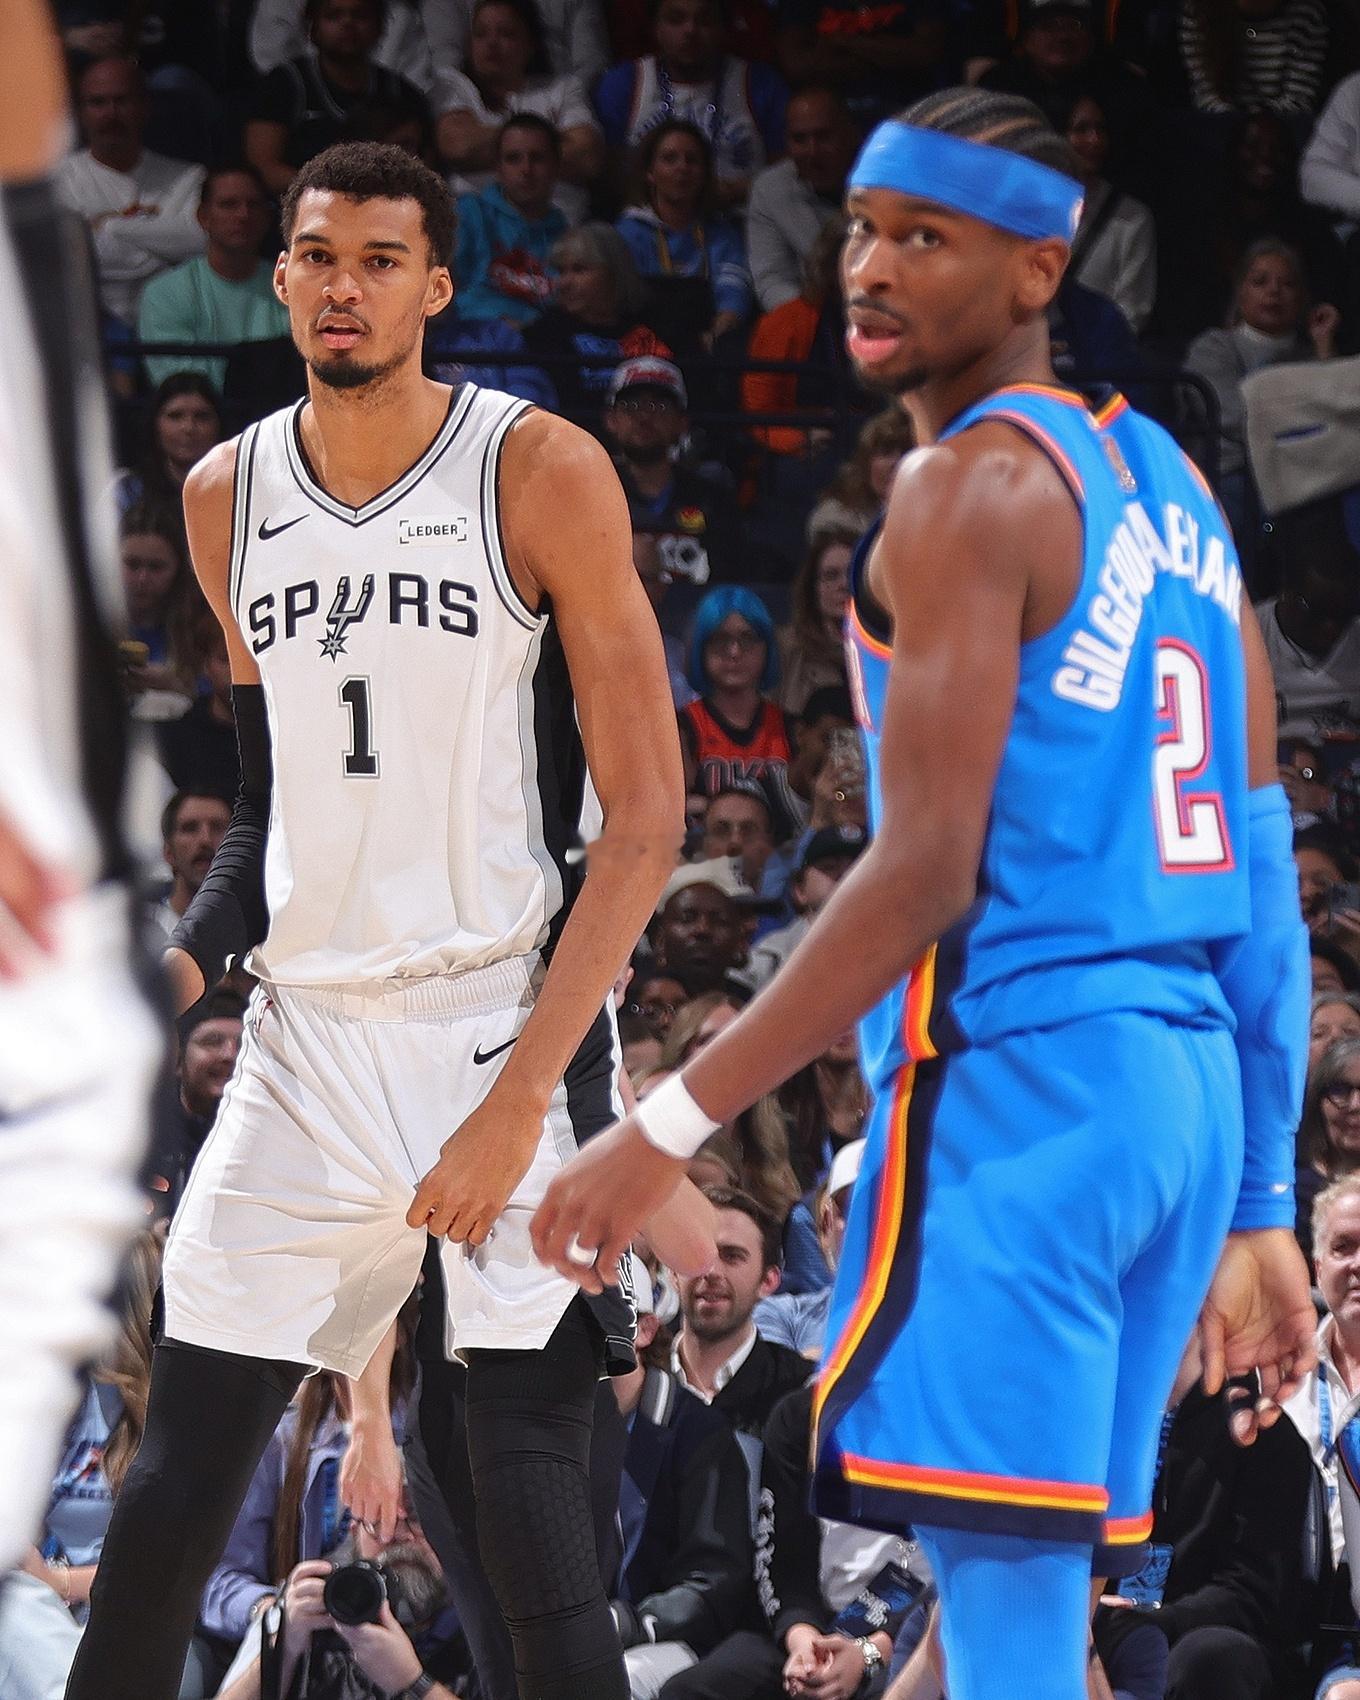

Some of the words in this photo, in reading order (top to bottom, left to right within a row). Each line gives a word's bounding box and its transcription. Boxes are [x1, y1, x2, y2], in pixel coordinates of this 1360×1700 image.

[407, 523, 458, 537] LEDGER
[249, 572, 479, 663] SPURS
[337, 674, 381, 779] 1
[1152, 636, 1236, 874] 2
